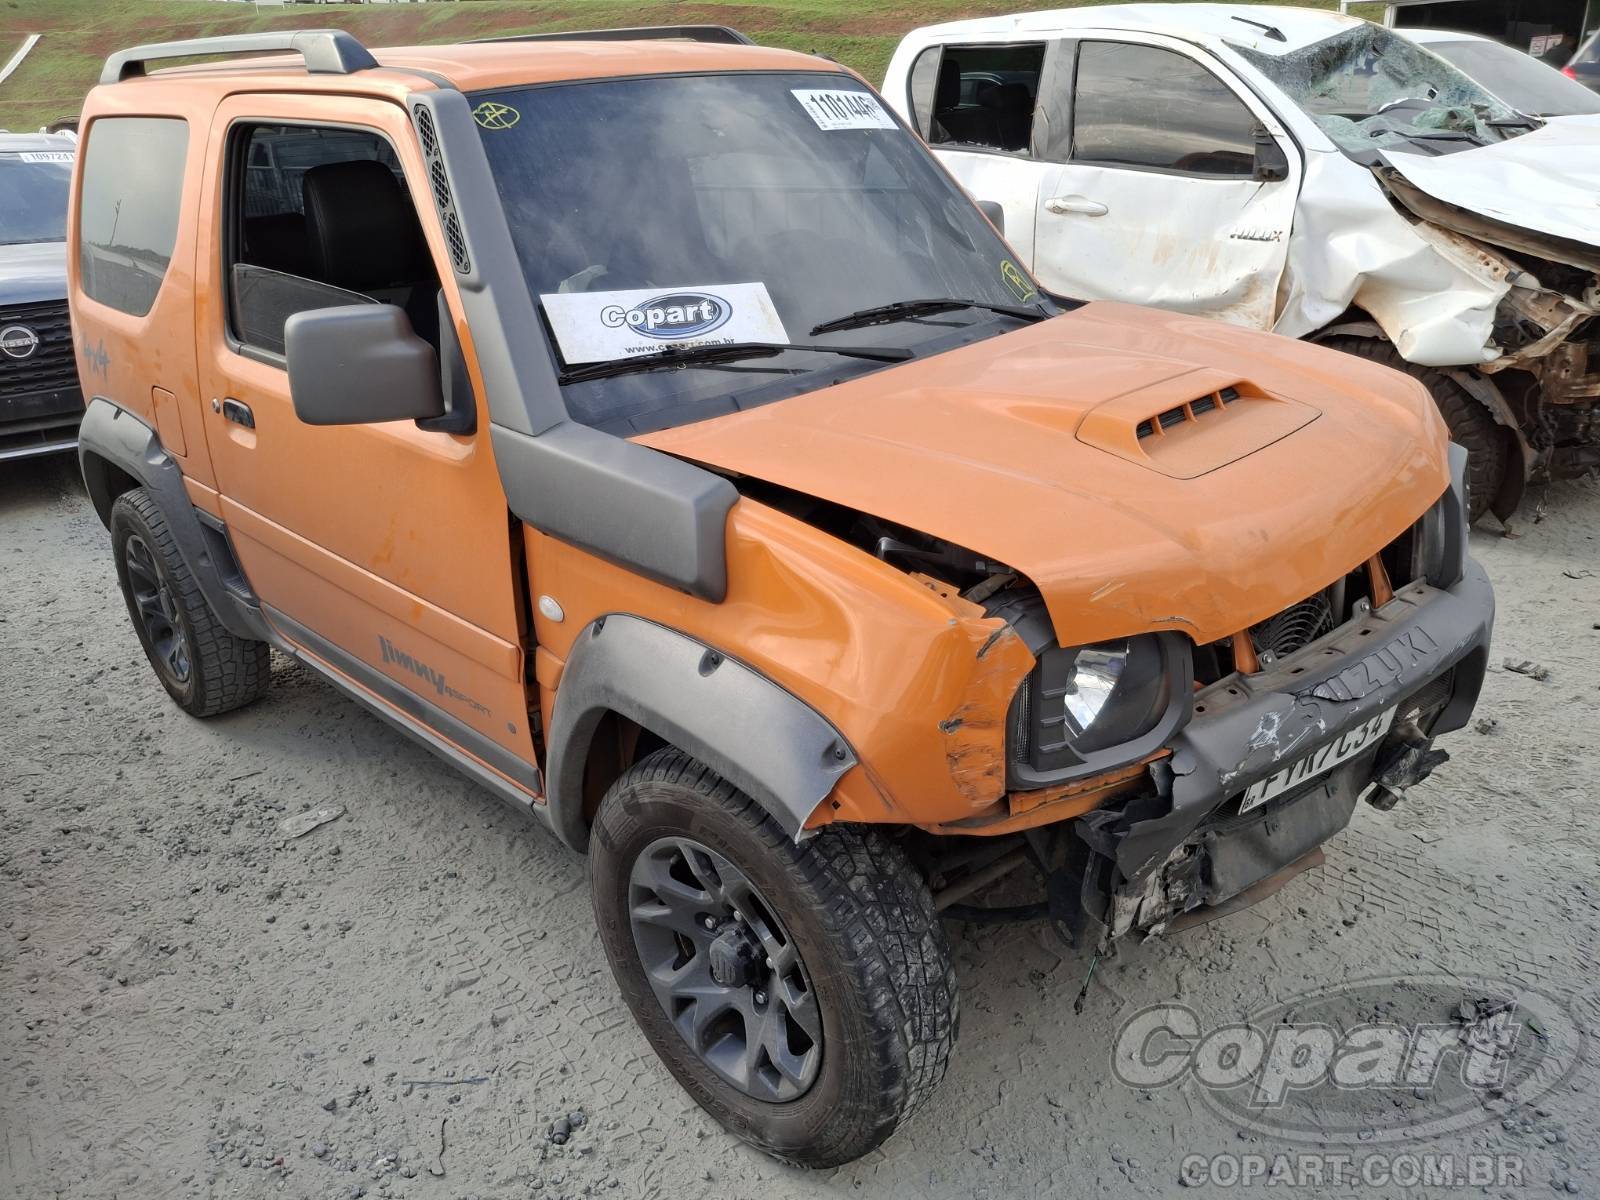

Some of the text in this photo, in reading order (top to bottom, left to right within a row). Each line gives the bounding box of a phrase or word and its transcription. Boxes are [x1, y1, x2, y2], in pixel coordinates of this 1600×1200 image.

[809, 93, 880, 121] 1101446
[600, 299, 714, 331] Copart
[624, 337, 735, 354] www.cart.com.br
